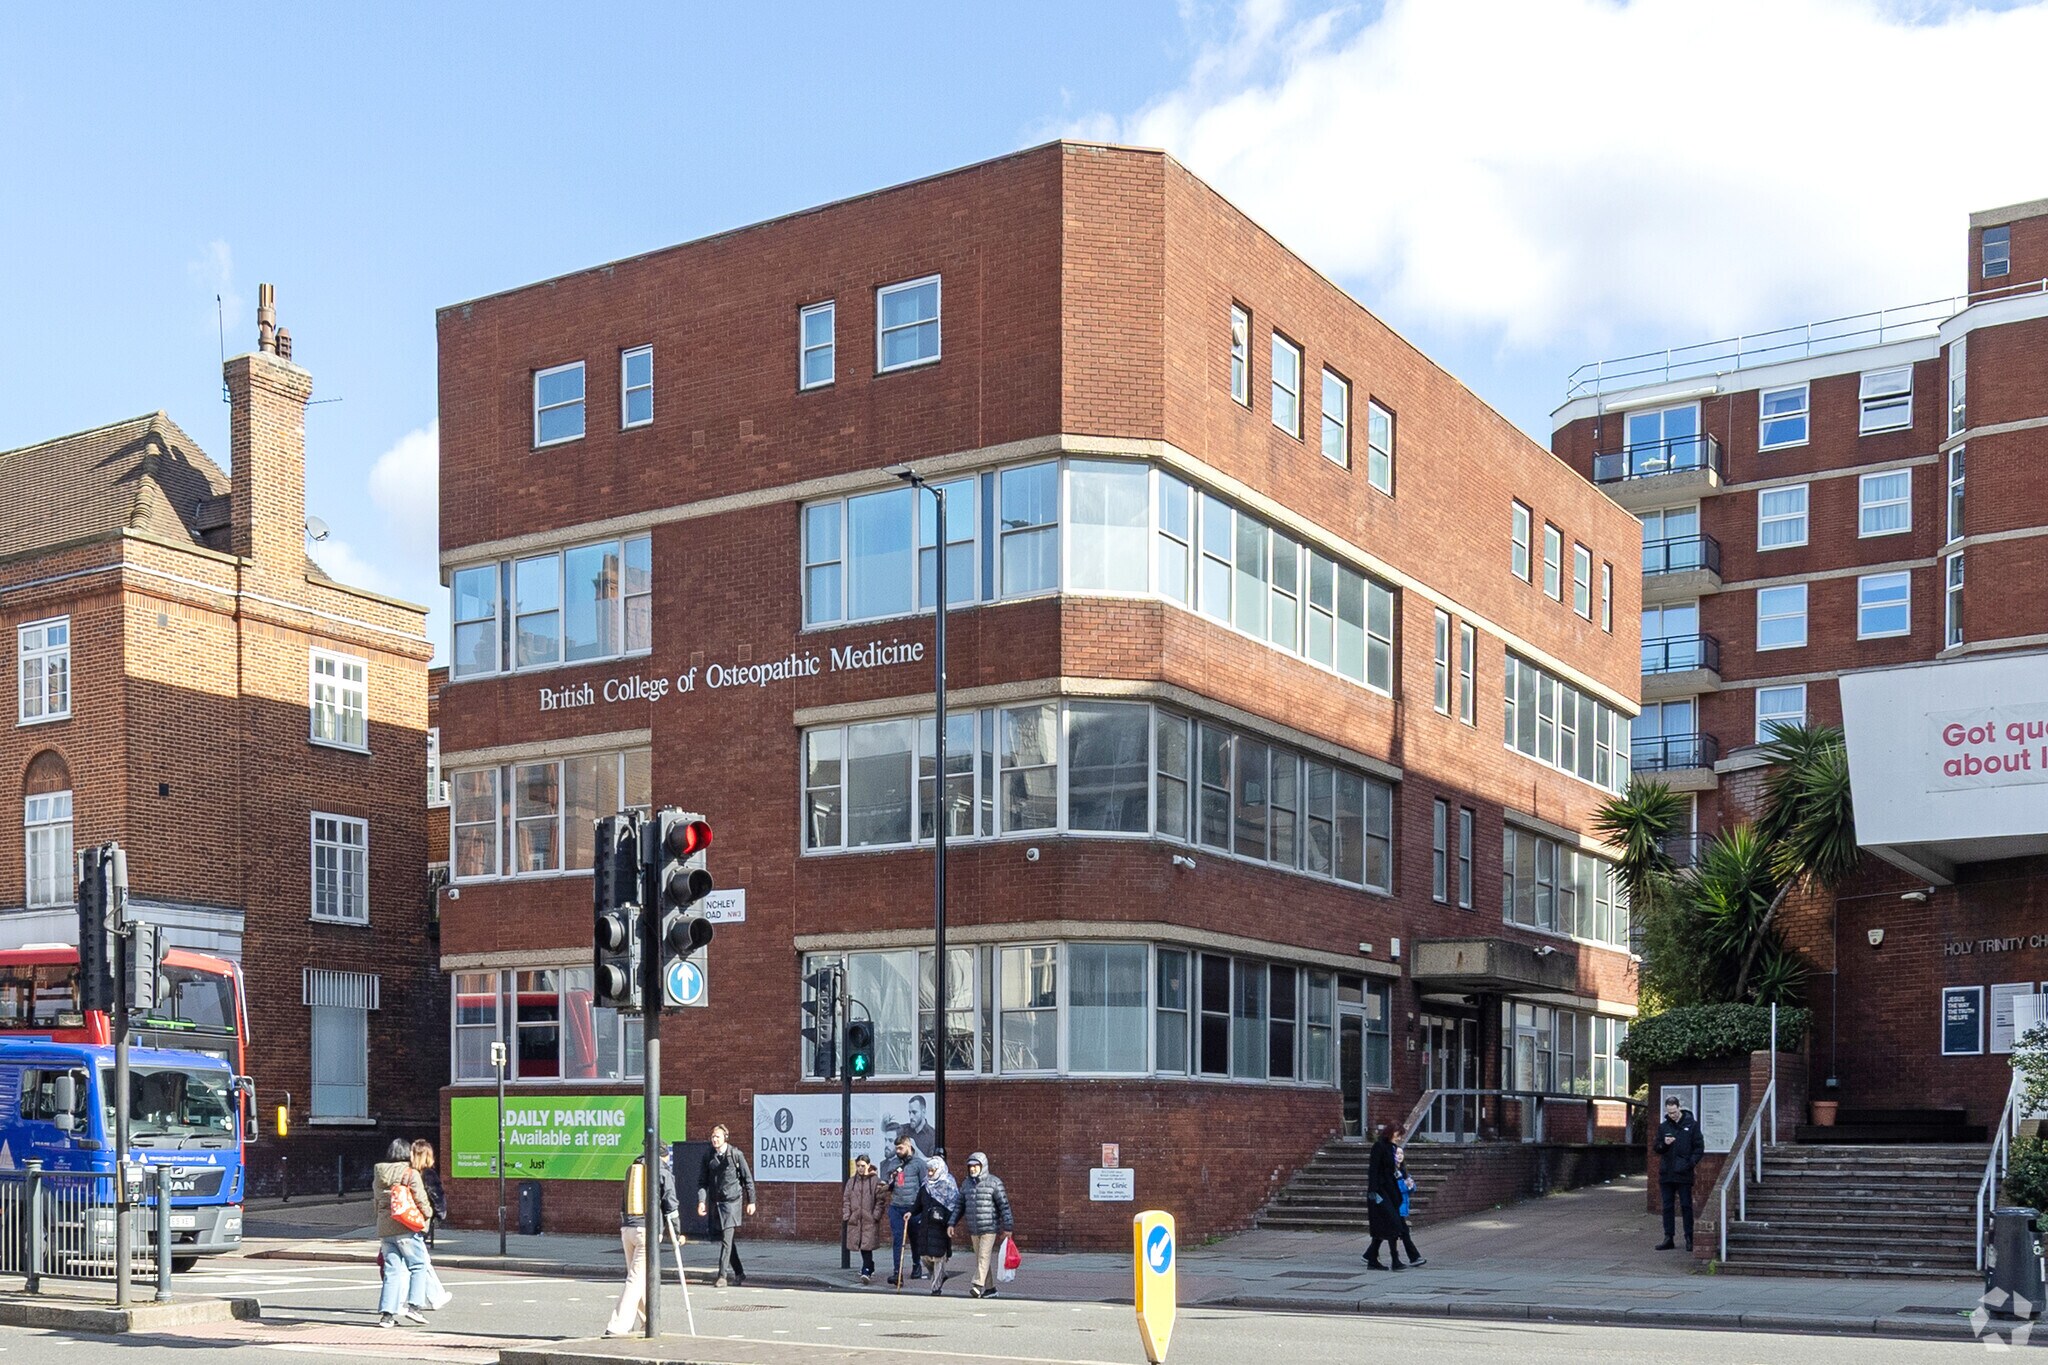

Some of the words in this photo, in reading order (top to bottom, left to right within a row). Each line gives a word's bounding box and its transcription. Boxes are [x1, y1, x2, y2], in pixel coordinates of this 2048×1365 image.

[539, 682, 595, 711] British
[603, 675, 669, 702] College
[677, 667, 697, 693] of
[706, 651, 820, 688] Osteopathic
[830, 638, 924, 673] Medicine
[1942, 721, 1996, 747] Got
[2006, 720, 2048, 745] qu
[1943, 748, 2031, 777] about
[706, 900, 736, 909] NCHLEY
[705, 910, 721, 919] OAD
[1944, 942, 1974, 956] HOLY
[1978, 937, 2025, 953] TRINITY
[506, 1109, 550, 1127] DAILY
[554, 1109, 625, 1127] PARKING
[509, 1129, 571, 1146] Available
[575, 1131, 589, 1146] at
[592, 1132, 622, 1146] rear
[820, 1127, 832, 1136] 15%
[834, 1127, 844, 1136] OF
[851, 1127, 859, 1136] ST
[860, 1127, 874, 1136] VISIT
[761, 1137, 808, 1152] DANY'S
[529, 1159, 545, 1169] Just
[760, 1154, 810, 1169] BARBER
